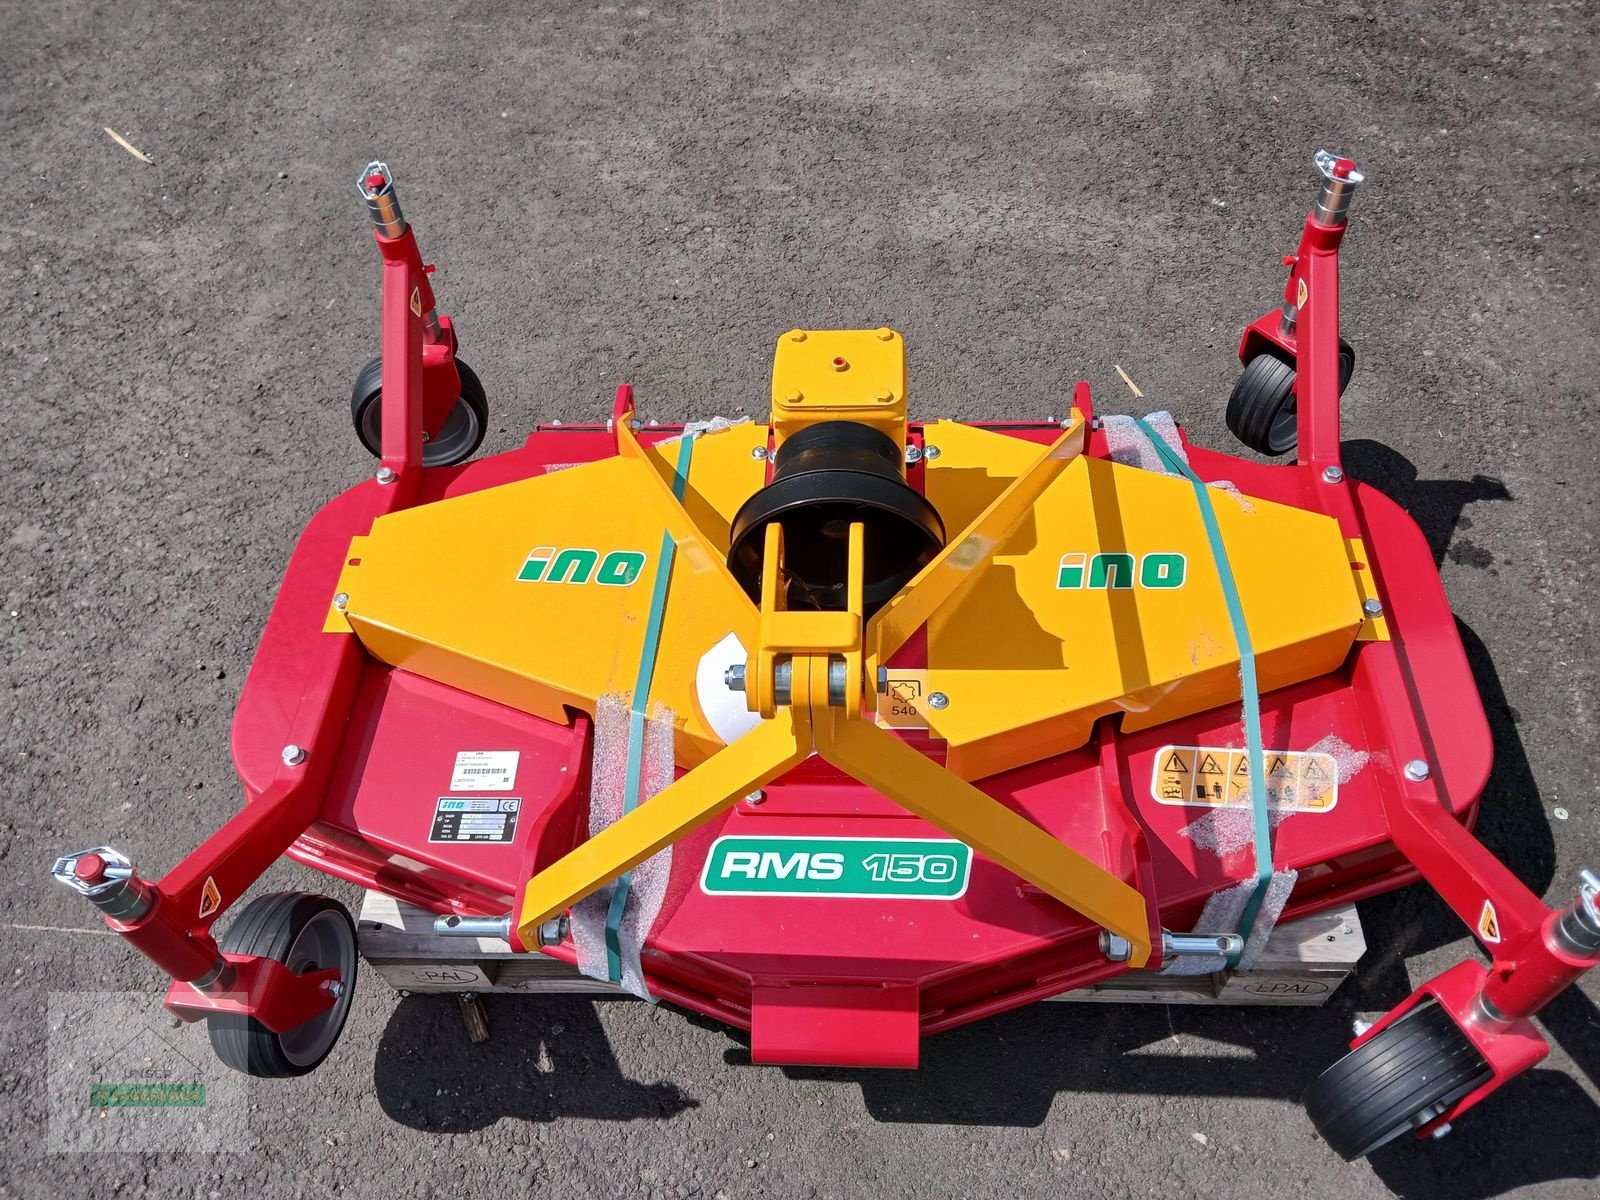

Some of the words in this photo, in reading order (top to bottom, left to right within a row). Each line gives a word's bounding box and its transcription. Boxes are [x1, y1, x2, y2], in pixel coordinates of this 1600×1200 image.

[891, 706, 917, 716] 540
[720, 851, 845, 880] RMS
[862, 853, 958, 883] 150
